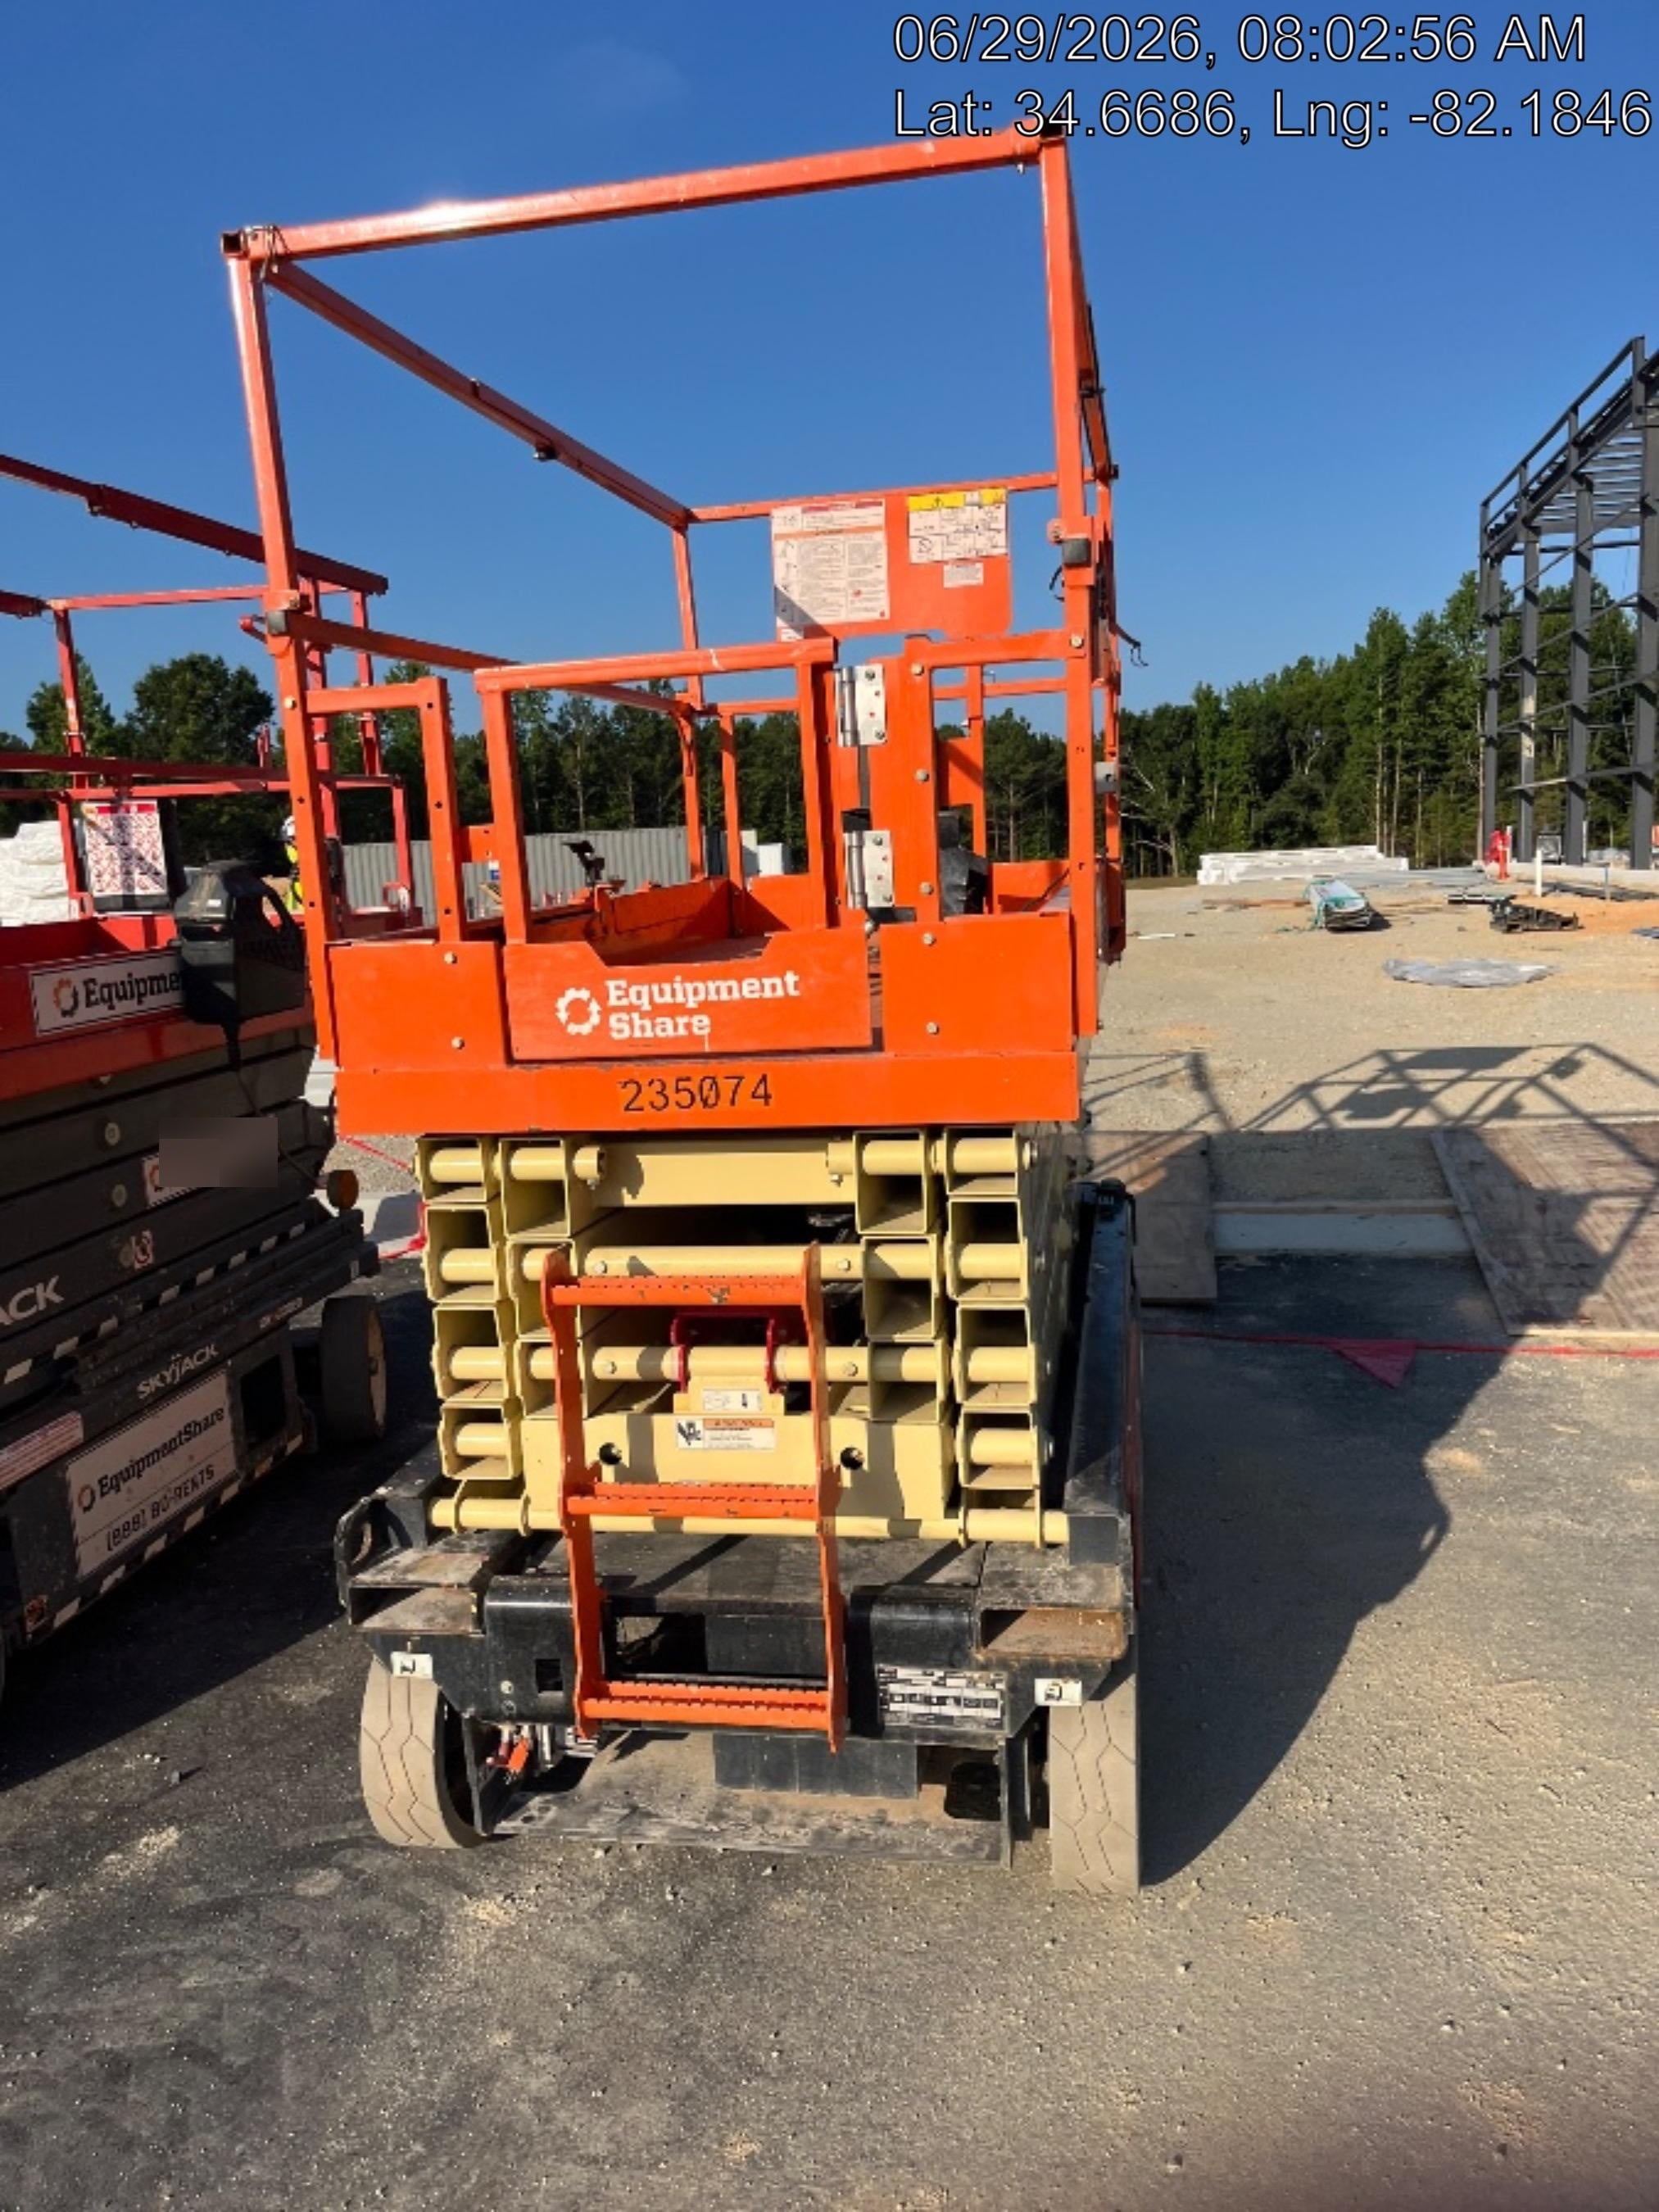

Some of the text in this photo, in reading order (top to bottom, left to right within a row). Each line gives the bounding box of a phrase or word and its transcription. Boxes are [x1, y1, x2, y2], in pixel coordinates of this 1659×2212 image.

[83, 972, 180, 1010] Equipme
[606, 970, 800, 1010] Equipment
[609, 1013, 711, 1040] Share
[620, 1074, 773, 1113] 235074
[136, 1344, 220, 1399] SKYJACK
[97, 1407, 225, 1500] EquipmentShare
